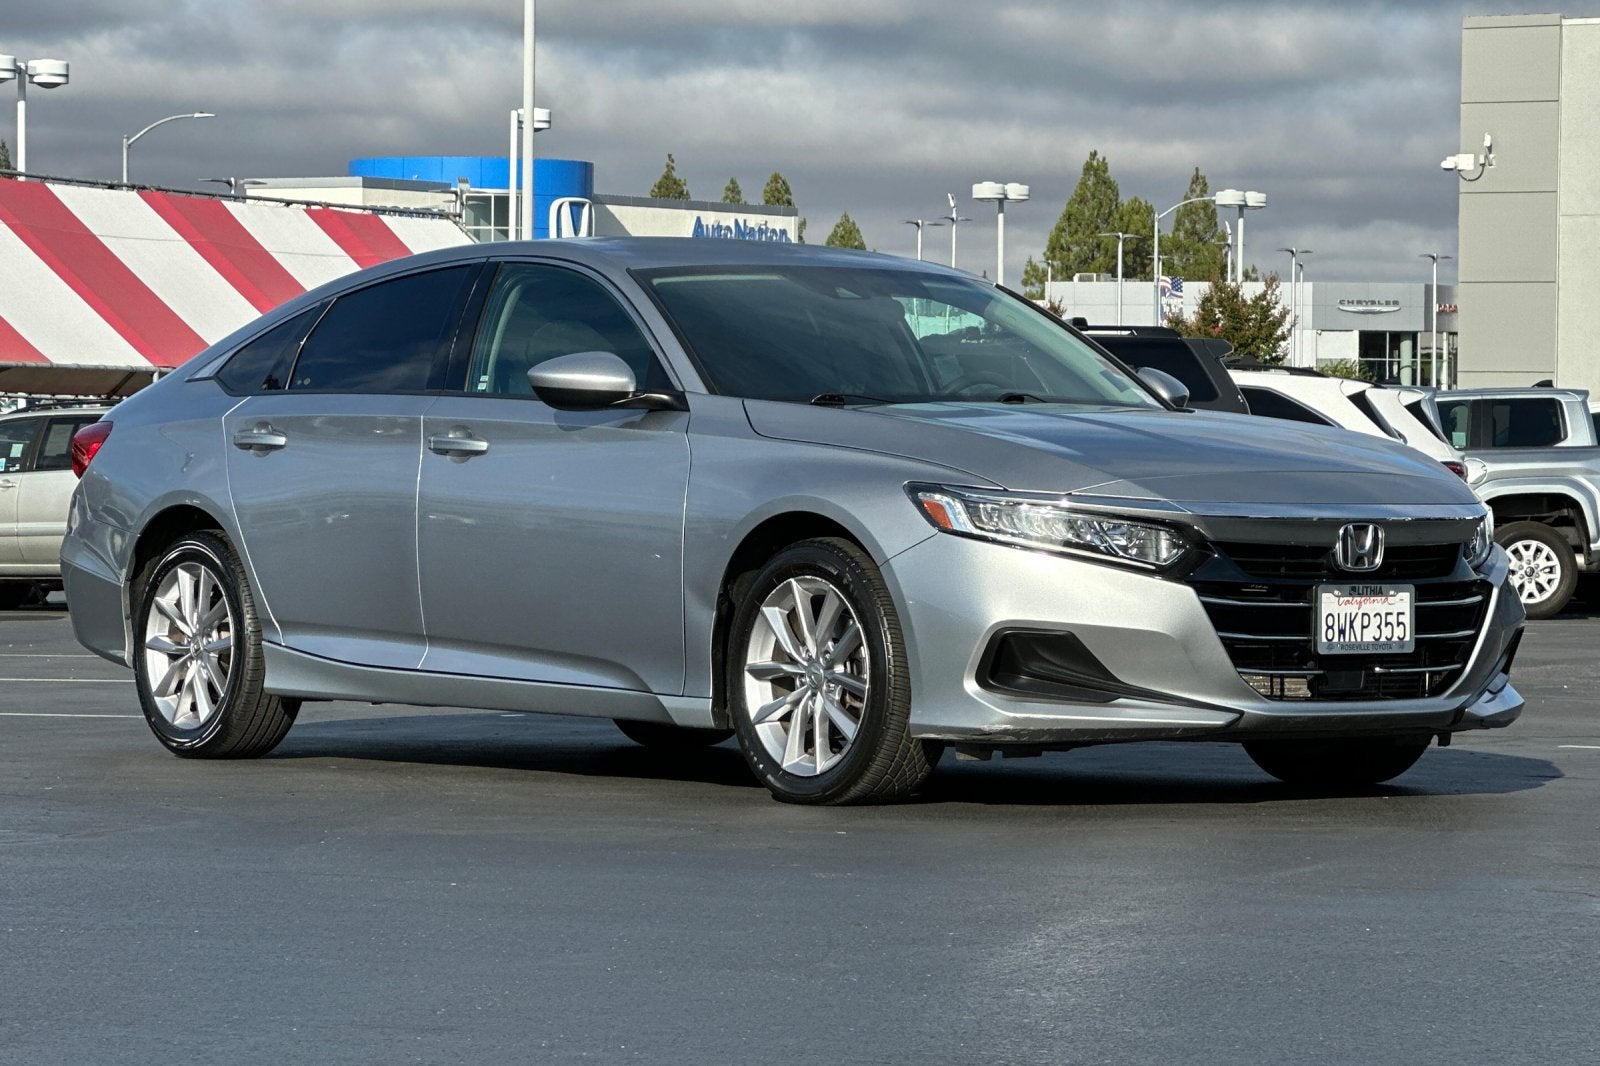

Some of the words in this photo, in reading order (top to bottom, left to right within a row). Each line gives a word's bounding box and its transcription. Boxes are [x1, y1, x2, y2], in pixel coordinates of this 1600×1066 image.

[692, 216, 788, 242] AutoNation
[1358, 586, 1384, 596] LITHIA
[1337, 596, 1395, 611] California
[1325, 611, 1407, 642] 8WKP355
[1340, 643, 1370, 651] ROSEVILLE
[1371, 642, 1393, 650] TOYOTA
